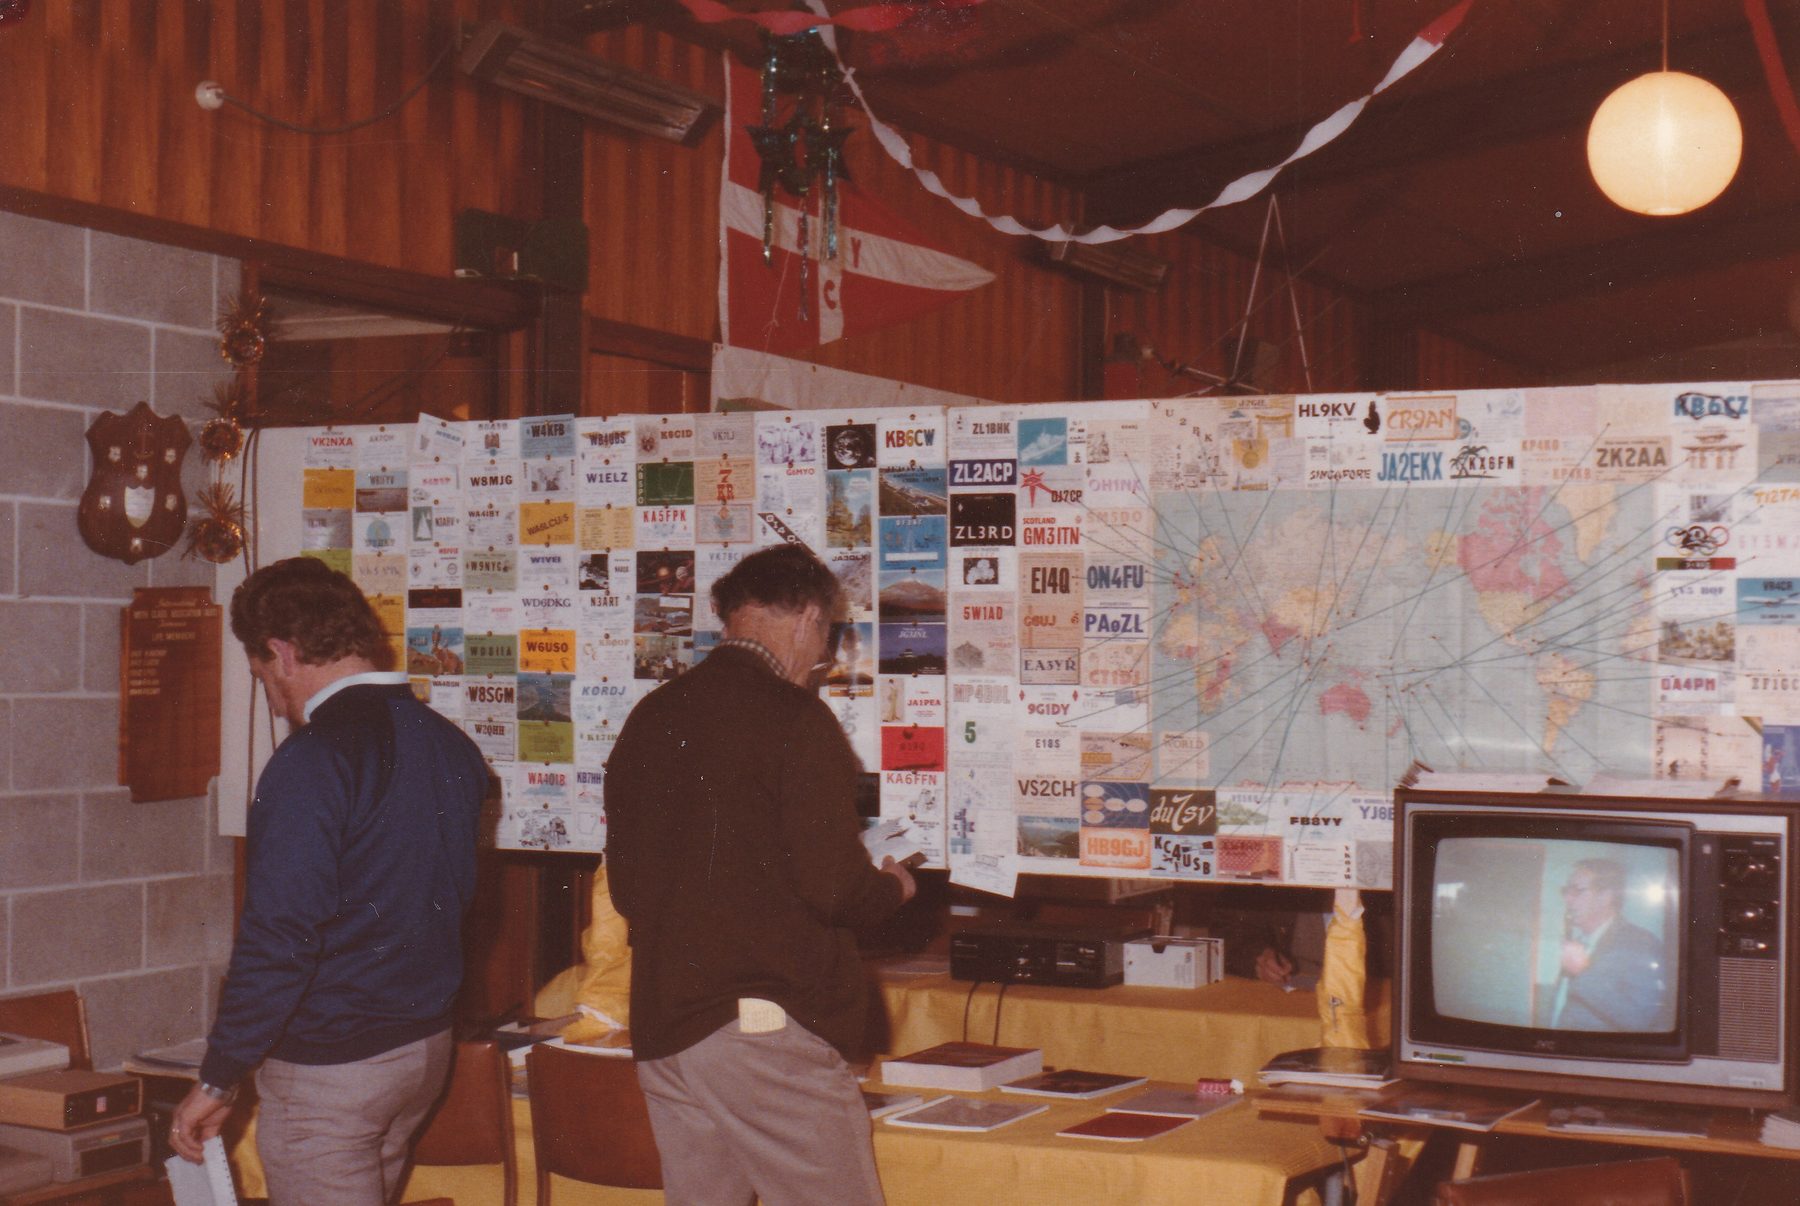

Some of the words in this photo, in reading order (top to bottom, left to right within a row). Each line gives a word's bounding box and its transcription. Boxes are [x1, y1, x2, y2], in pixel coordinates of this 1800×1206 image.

[1299, 402, 1356, 417] HL9KV
[886, 429, 935, 448] KB6CW
[1377, 452, 1443, 481] JA2EKX
[1596, 447, 1667, 467] ZK2AA
[953, 463, 1013, 483] ZL2ACP
[955, 526, 1013, 540] ZL3RD
[1087, 565, 1144, 589] ON4FU
[1018, 780, 1075, 797] VS2CH
